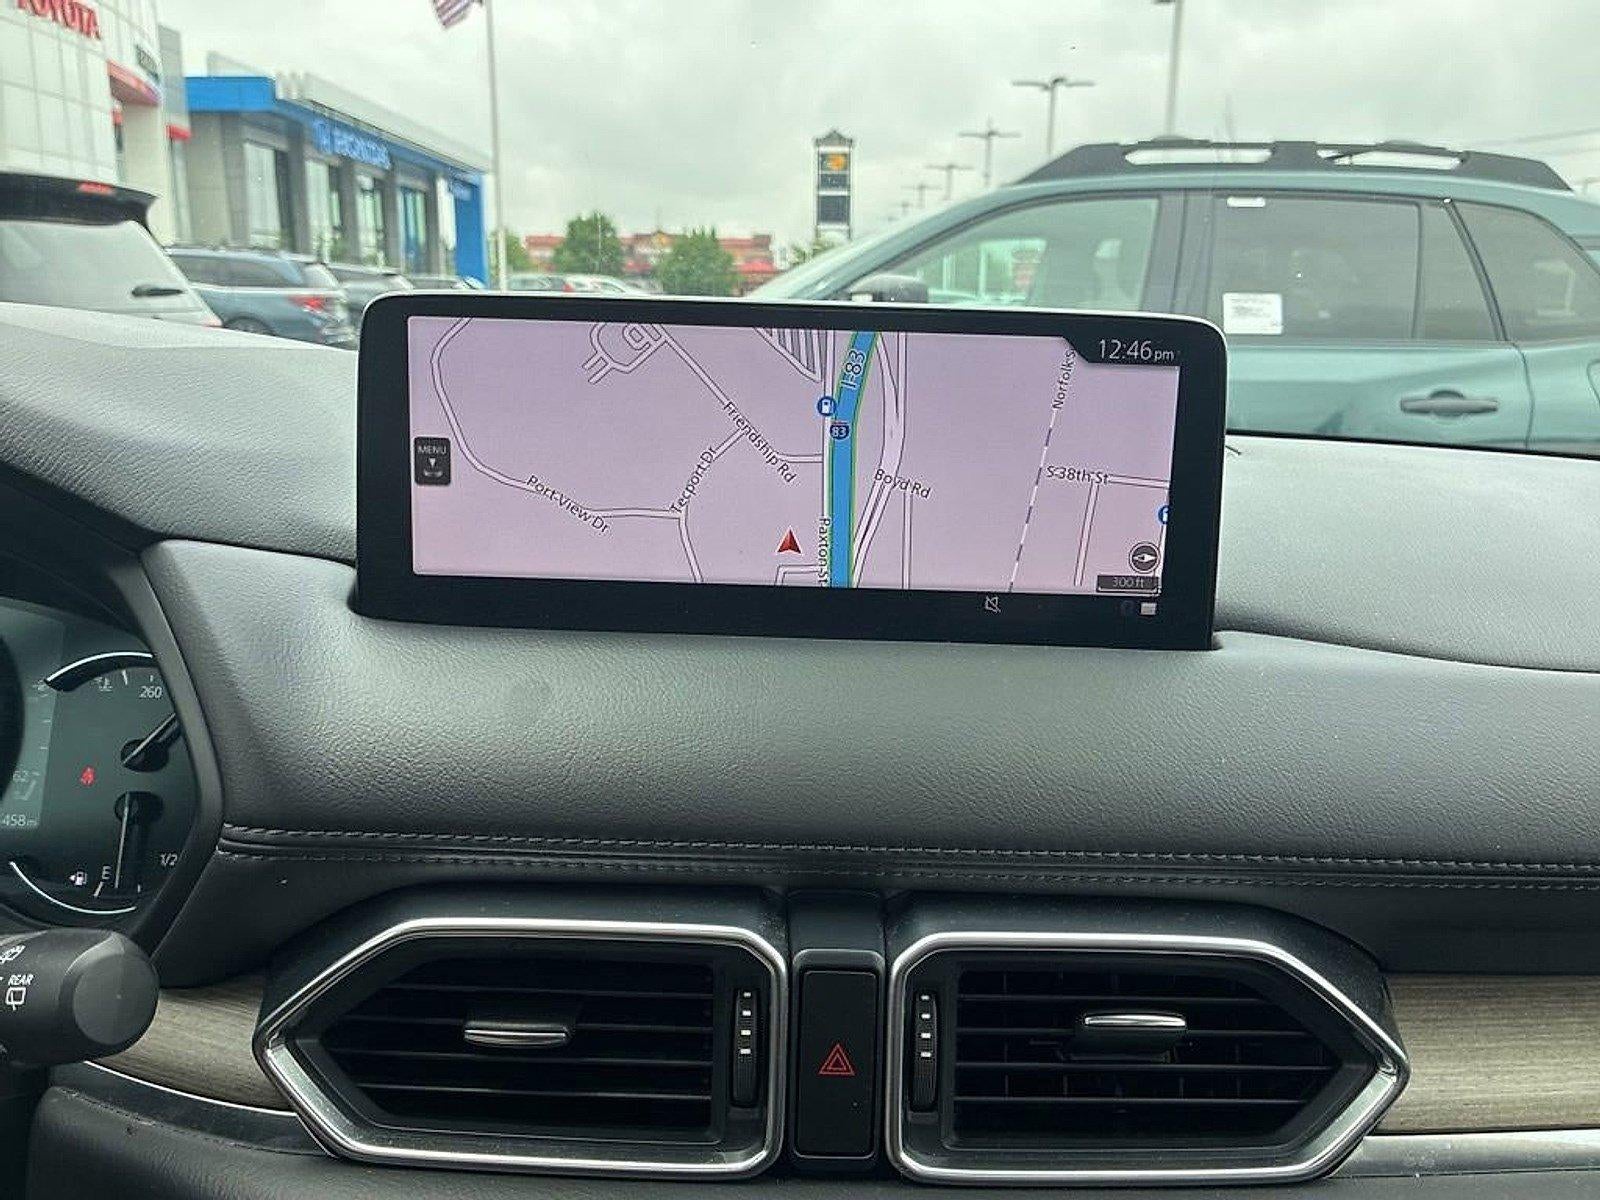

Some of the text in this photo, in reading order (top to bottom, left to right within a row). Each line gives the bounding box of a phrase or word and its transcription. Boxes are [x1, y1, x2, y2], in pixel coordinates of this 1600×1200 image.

[1099, 339, 1175, 362] 12:46 pm
[840, 349, 866, 388] I-83
[1052, 359, 1076, 409] Norfolk
[723, 401, 797, 482] Friendship Rd
[833, 427, 847, 438] 83
[417, 445, 447, 455] MENU
[669, 446, 717, 513] Tecport Dr
[875, 468, 931, 499] Boyd Rd
[1058, 466, 1092, 482] 38th
[1095, 471, 1108, 485] St
[526, 474, 609, 533] Port View Dr
[818, 517, 831, 567] Paxton
[139, 685, 163, 699] 260
[101, 865, 113, 880] E
[8, 973, 35, 986] REAR
